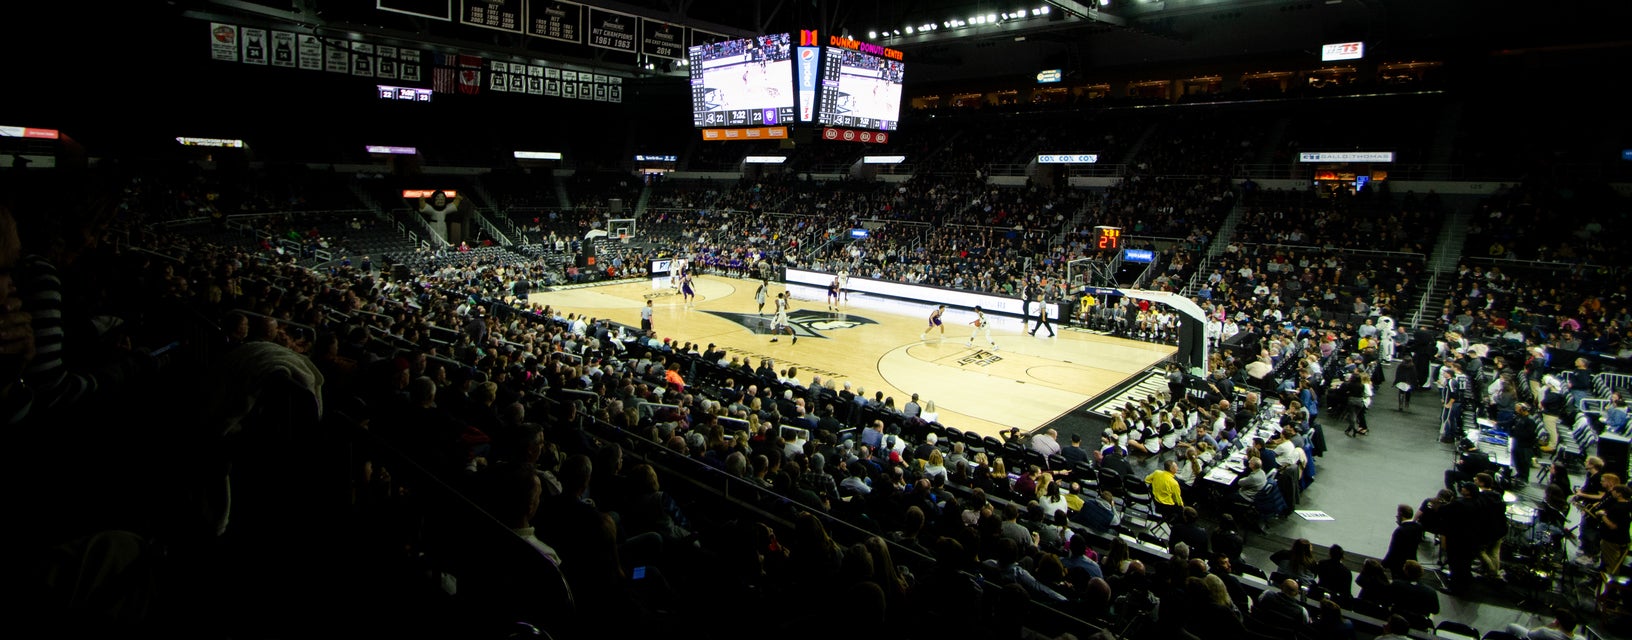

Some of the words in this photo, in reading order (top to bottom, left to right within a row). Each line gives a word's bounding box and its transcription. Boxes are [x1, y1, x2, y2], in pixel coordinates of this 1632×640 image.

[596, 36, 611, 45] 1961
[614, 40, 631, 48] 1963
[830, 36, 860, 50] DUNKIN'
[860, 42, 884, 55] DONUTS
[884, 48, 903, 60] CENTER
[656, 47, 671, 55] 2014
[1099, 236, 1116, 248] 27
